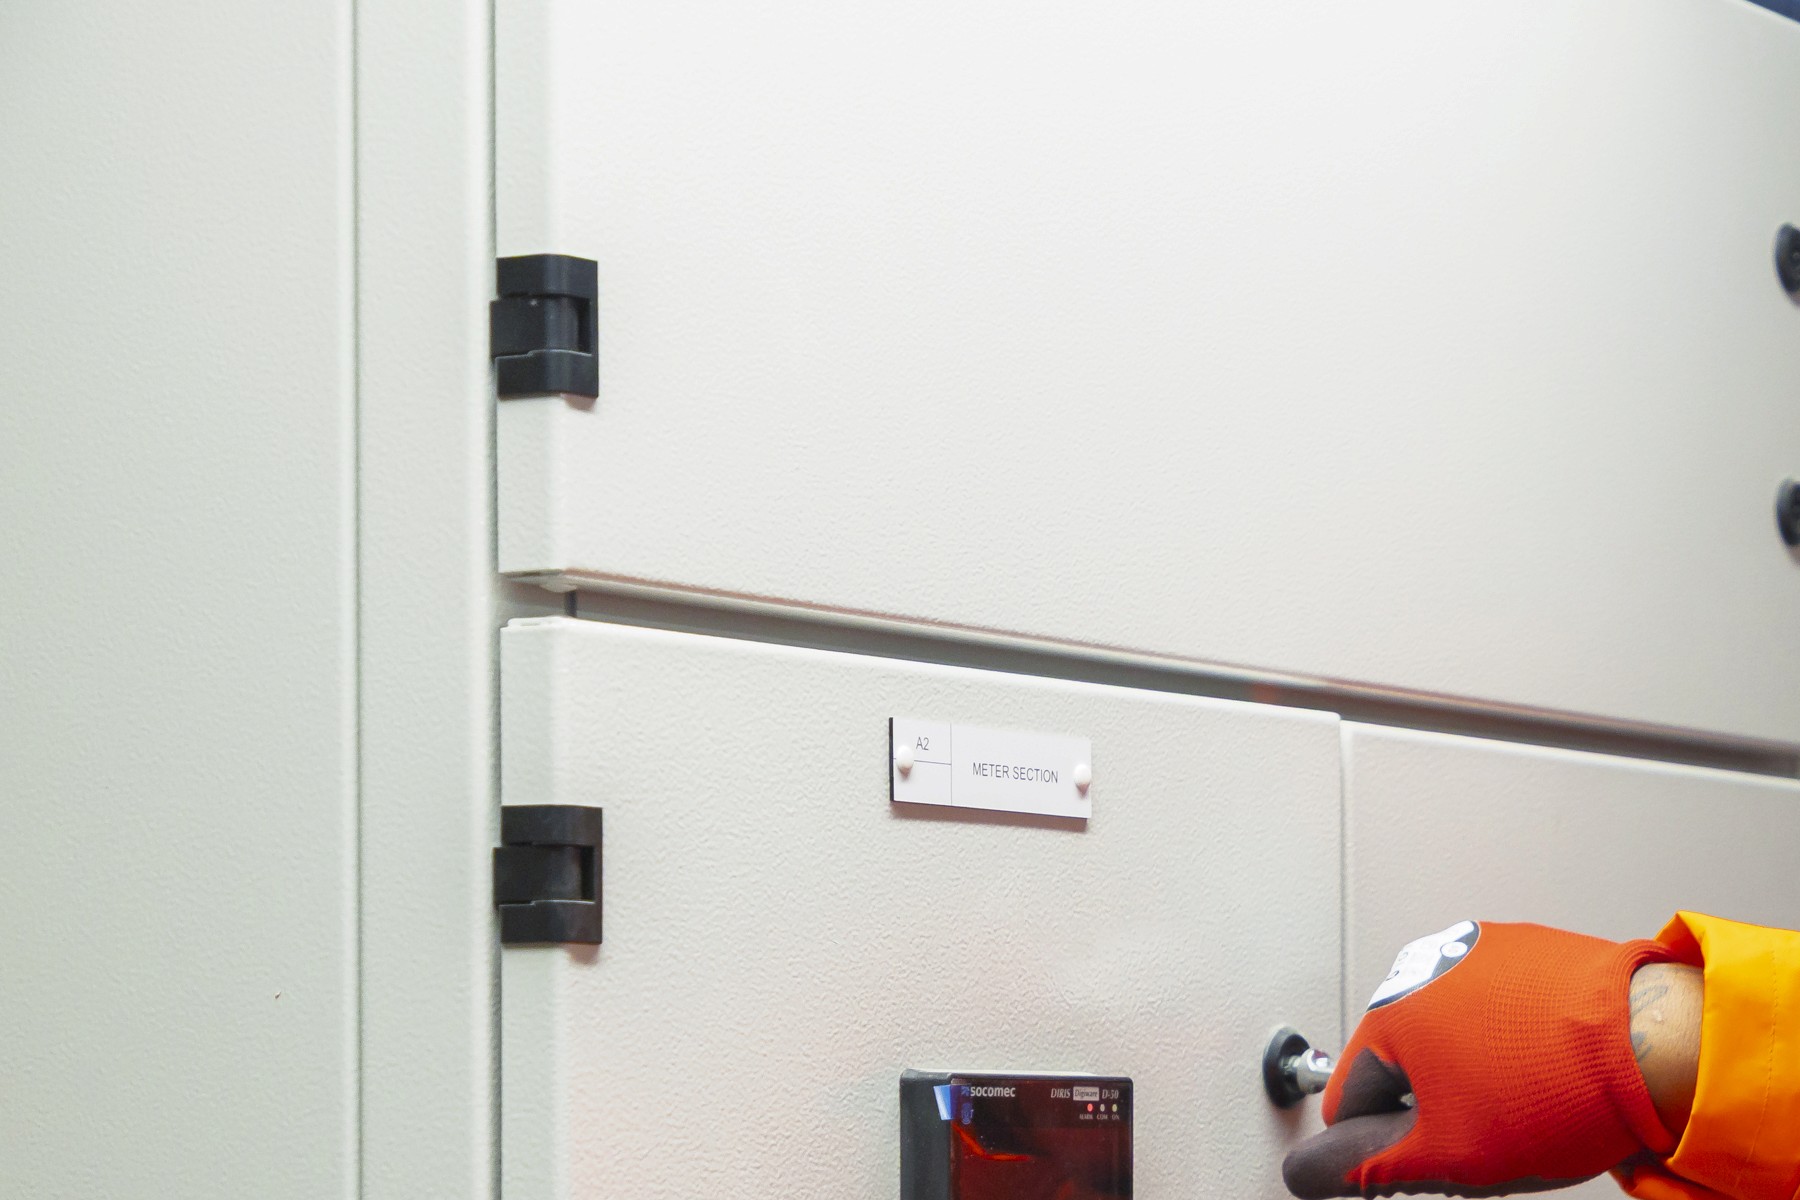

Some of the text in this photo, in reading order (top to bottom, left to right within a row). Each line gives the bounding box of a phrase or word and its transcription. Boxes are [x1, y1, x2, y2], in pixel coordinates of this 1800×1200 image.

[916, 736, 930, 751] A2
[972, 762, 1059, 783] METER SECTION
[970, 1086, 1016, 1098] socomec
[1050, 1087, 1072, 1099] DIRIS
[1101, 1088, 1119, 1100] D-50
